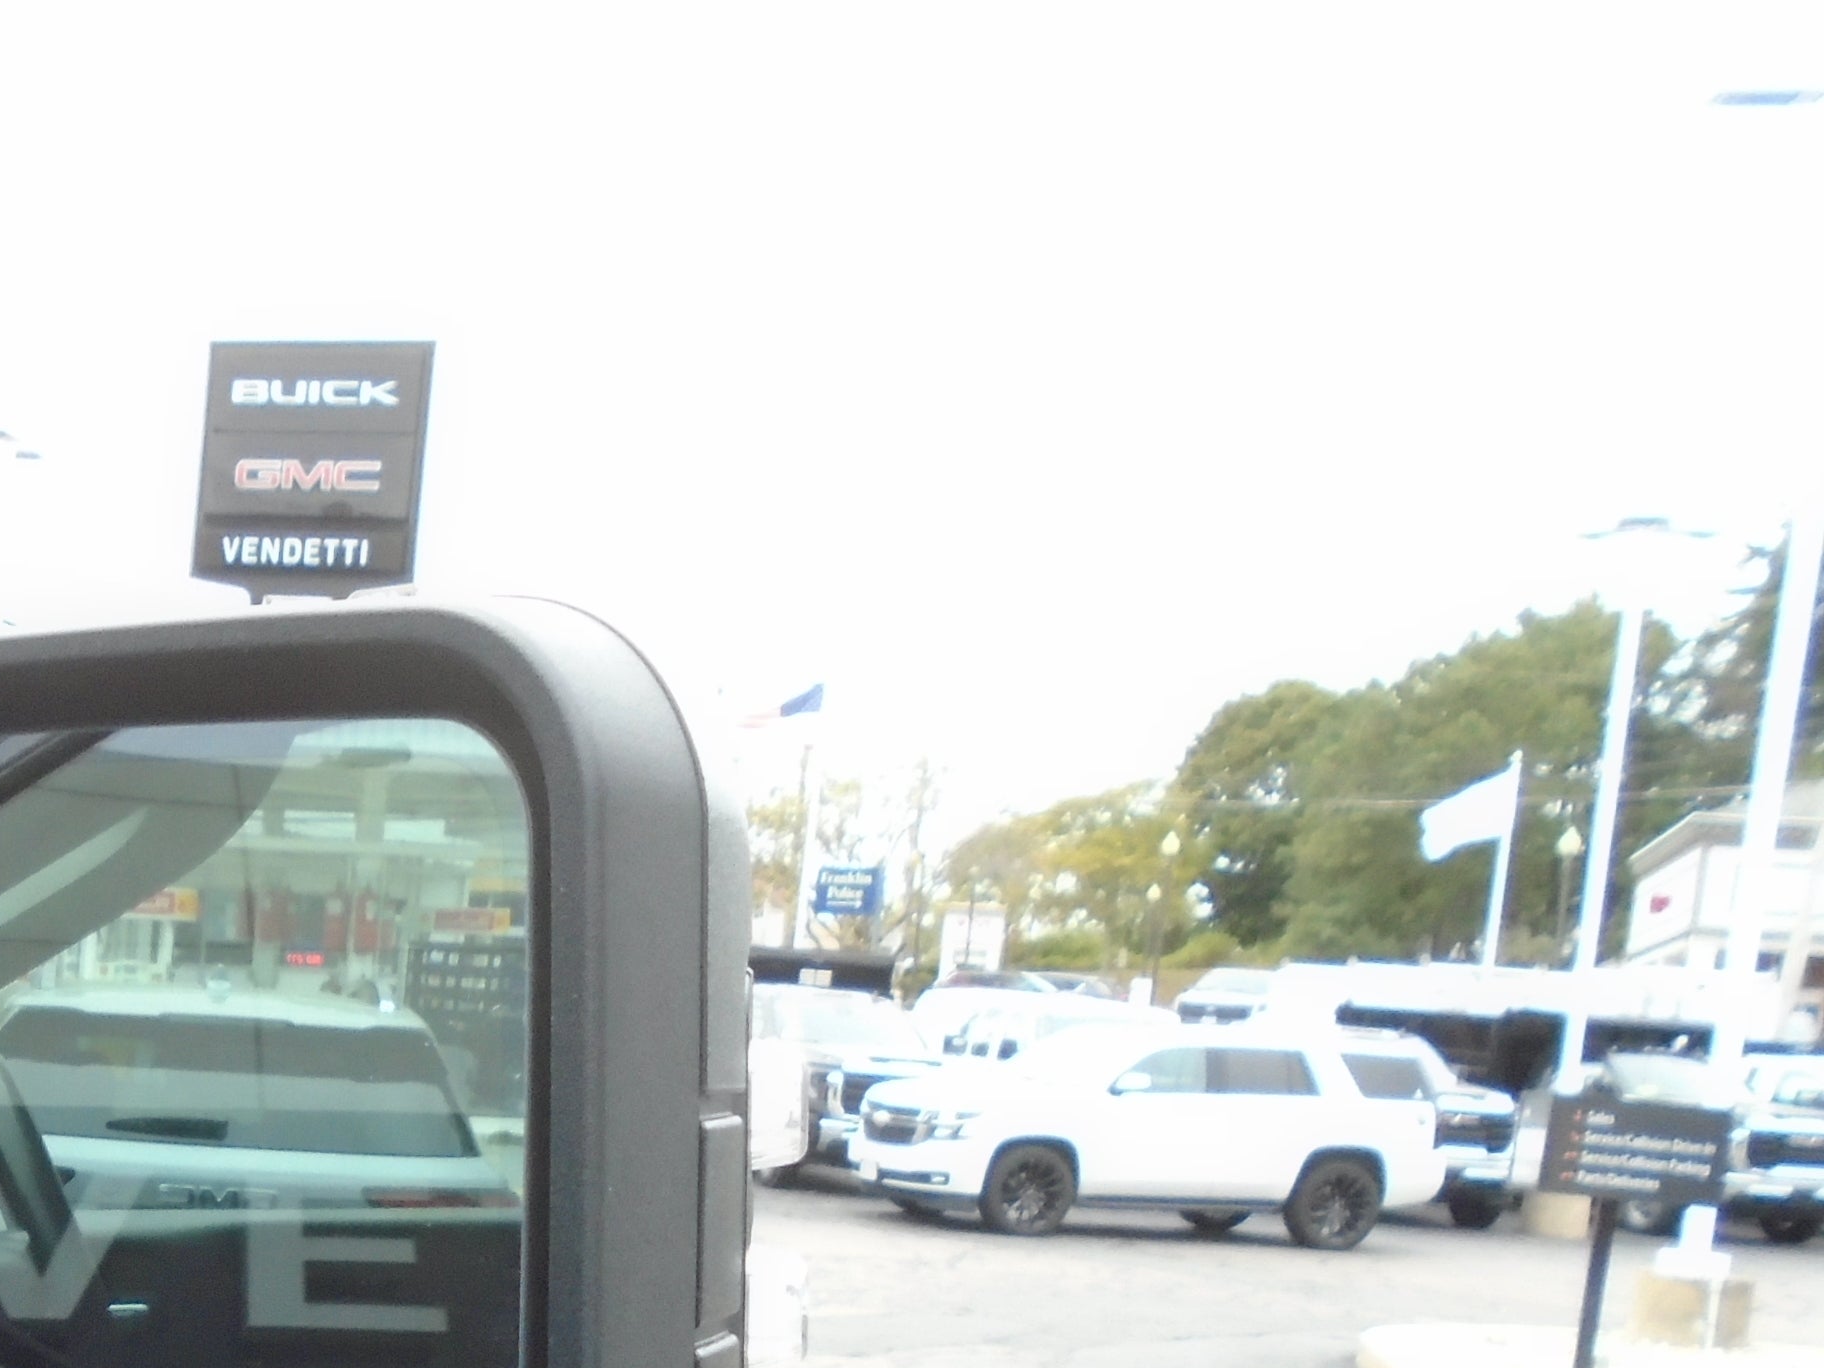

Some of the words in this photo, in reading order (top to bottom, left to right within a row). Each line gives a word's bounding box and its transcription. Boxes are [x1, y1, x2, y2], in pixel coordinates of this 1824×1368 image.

[231, 379, 400, 405] BUICK
[234, 458, 382, 491] GMC
[222, 536, 369, 567] VENDETTI
[820, 871, 873, 886] Franklin
